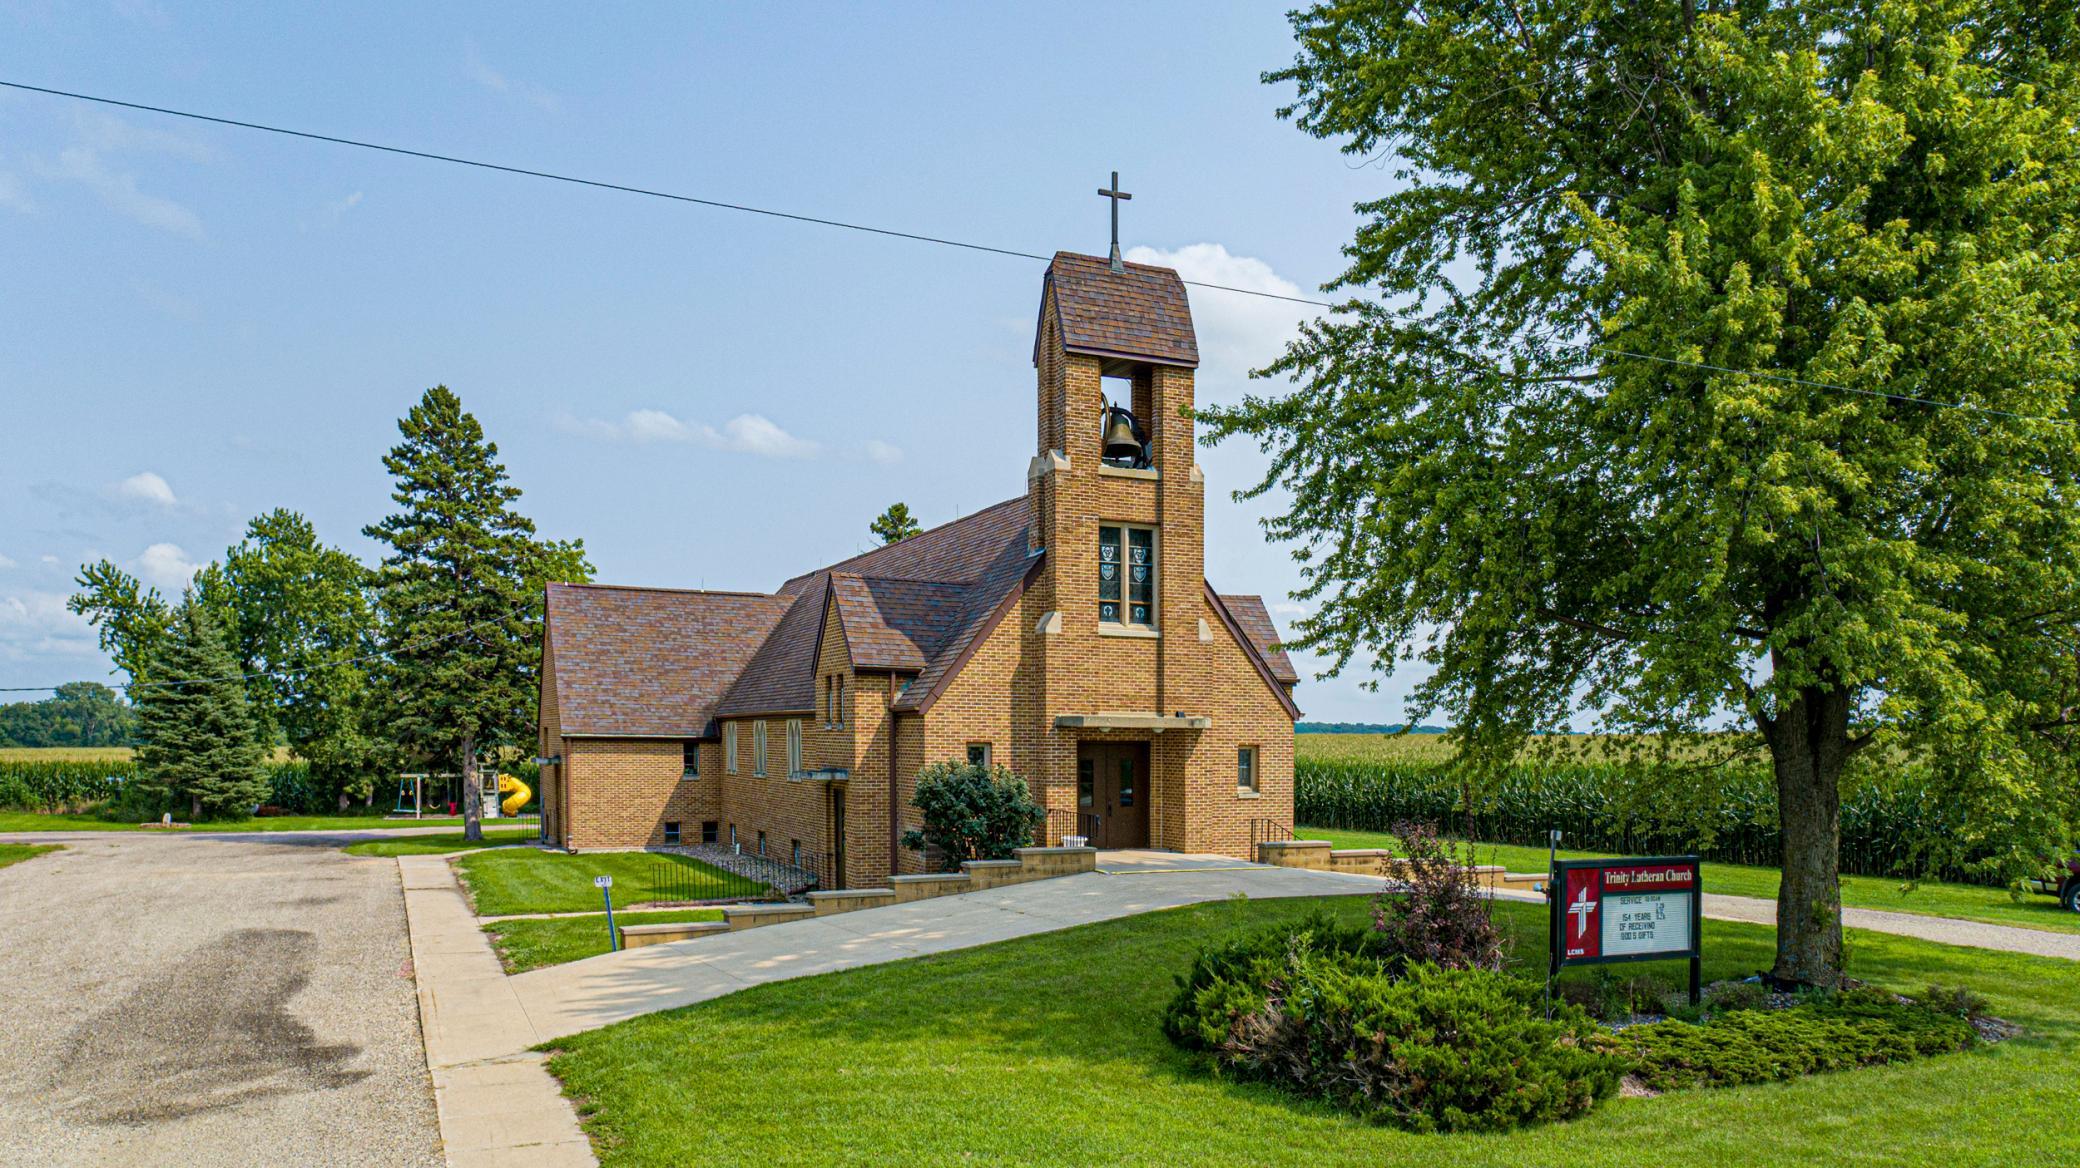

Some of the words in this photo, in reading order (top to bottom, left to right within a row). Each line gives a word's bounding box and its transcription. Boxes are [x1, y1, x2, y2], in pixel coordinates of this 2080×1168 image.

[1604, 871, 1629, 887] Trinity
[1631, 869, 1664, 883] Lutheran
[1666, 868, 1692, 882] Church
[1620, 896, 1642, 905] SERVICE
[1634, 912, 1651, 921] YEARS
[1619, 923, 1626, 931] OF
[1628, 921, 1655, 931] RECEIVING
[1638, 930, 1654, 939] GIFTS
